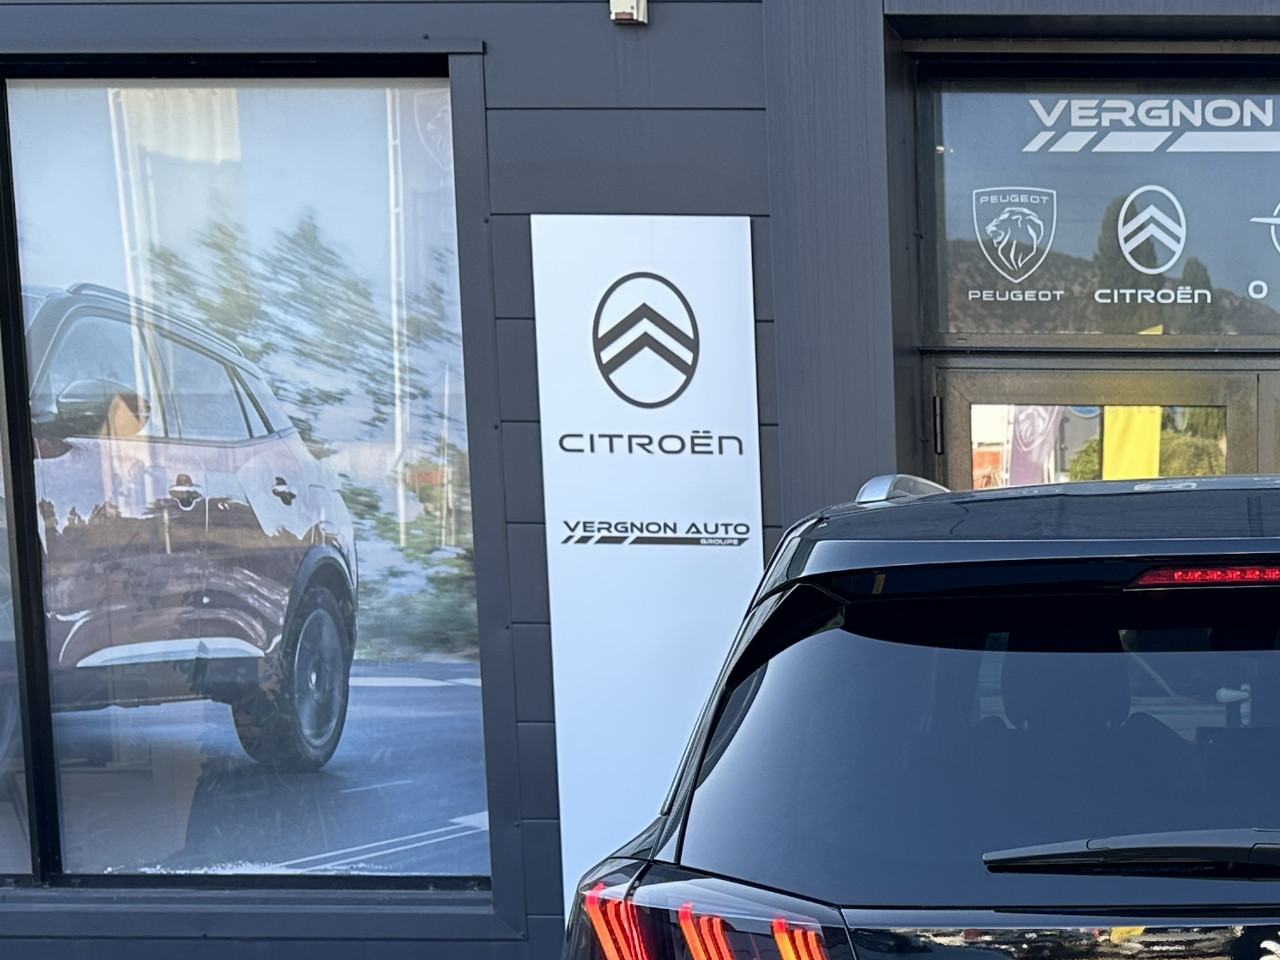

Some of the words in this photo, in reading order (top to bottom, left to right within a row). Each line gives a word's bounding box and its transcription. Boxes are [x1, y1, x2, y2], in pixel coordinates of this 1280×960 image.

[1028, 98, 1274, 127] VERGNON
[979, 193, 1049, 206] PEUGEOT
[968, 288, 1065, 302] PEUGEOT
[563, 520, 678, 534] VERGNON
[685, 522, 750, 536] AUTO
[700, 538, 739, 546] GROUPE
